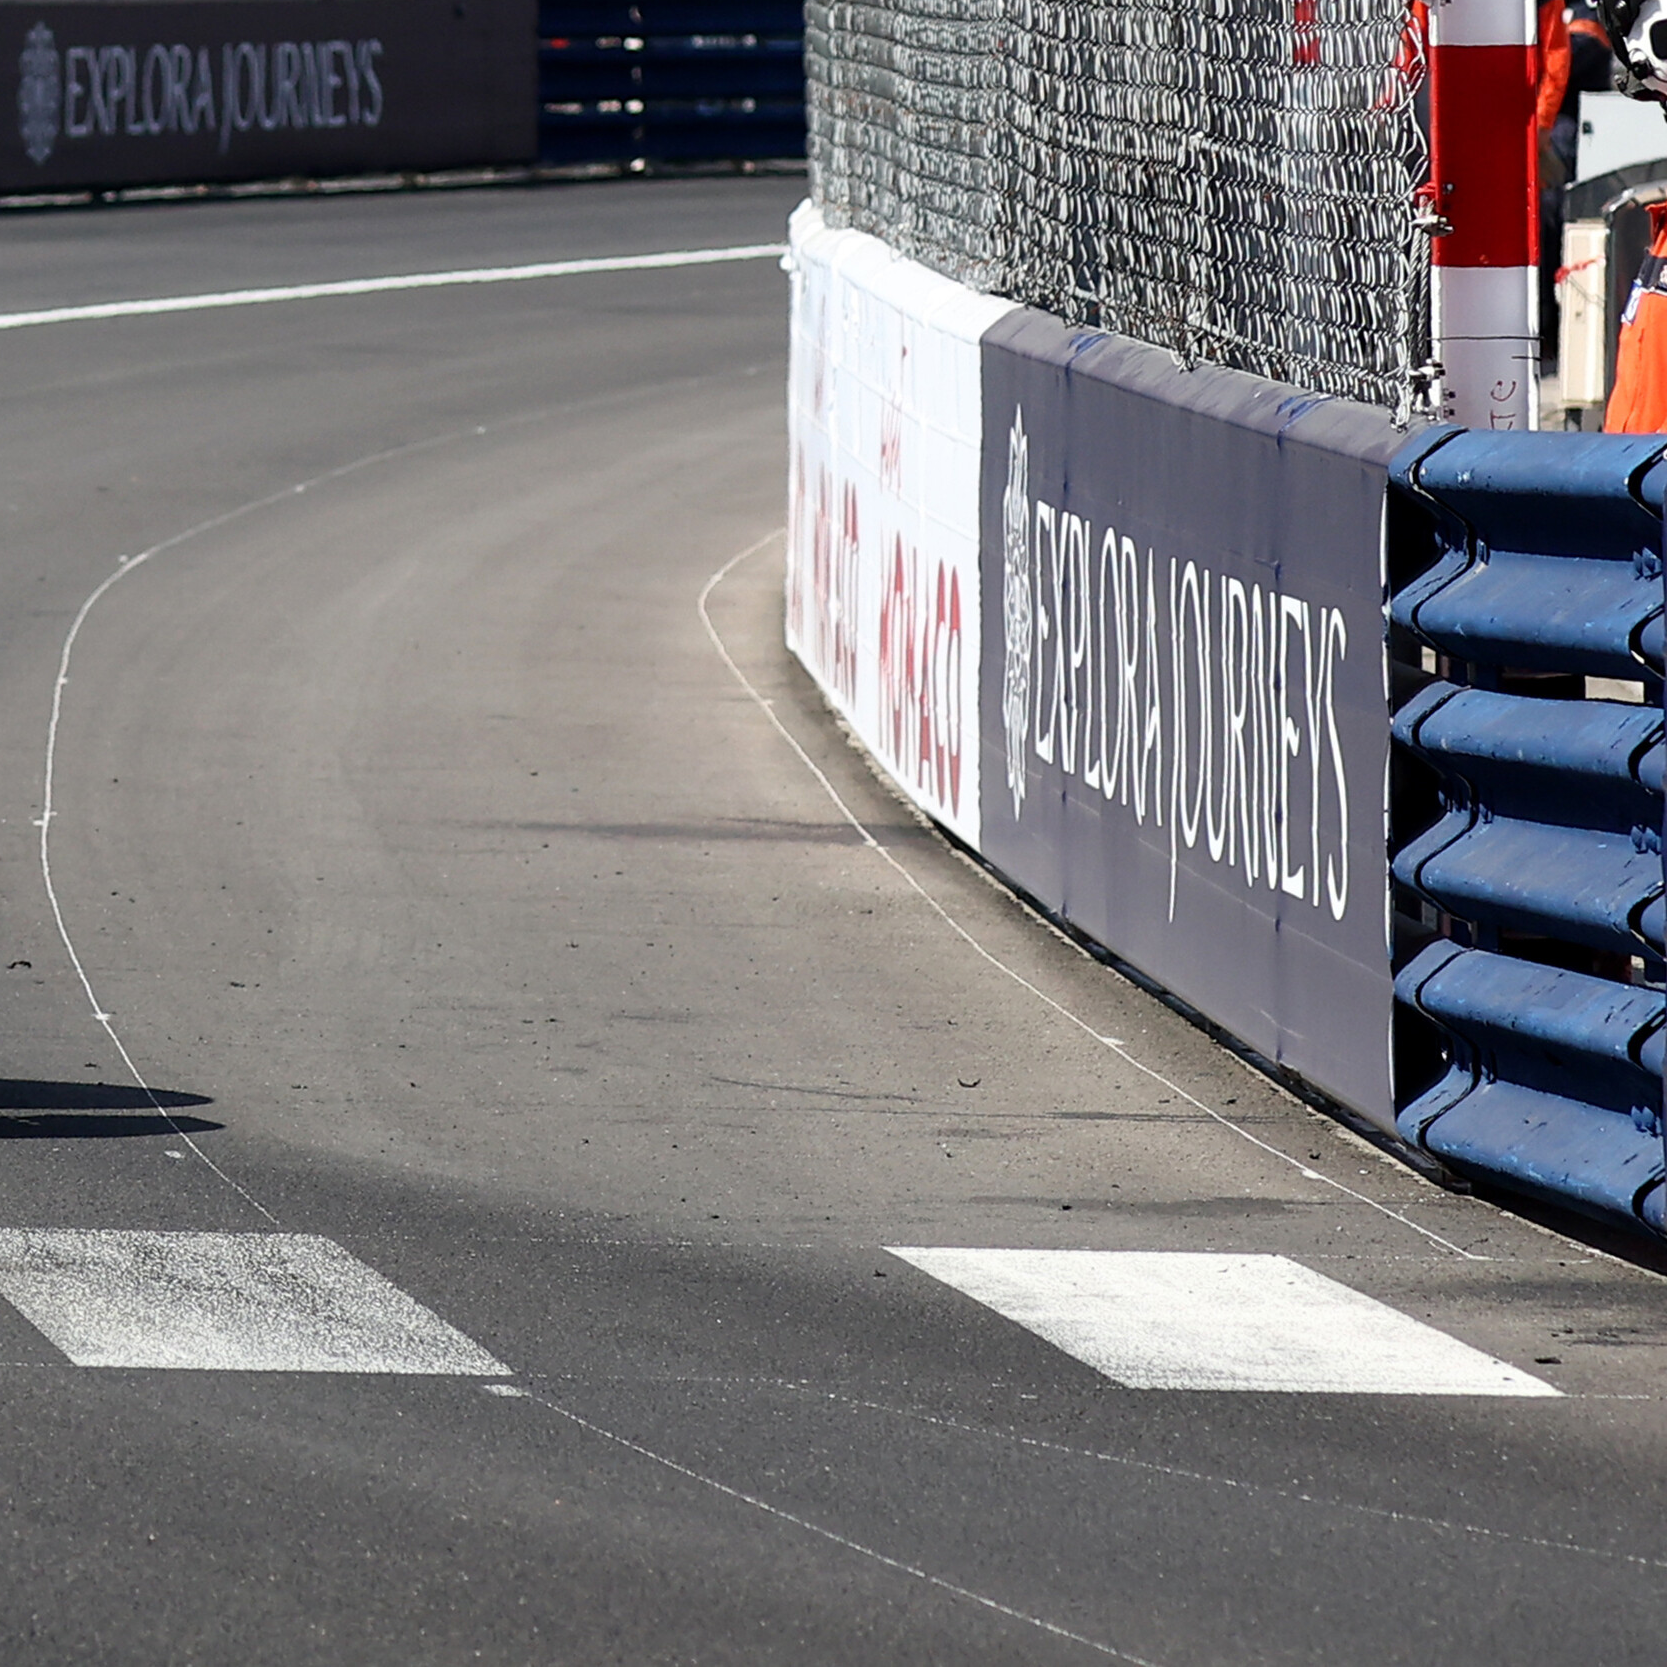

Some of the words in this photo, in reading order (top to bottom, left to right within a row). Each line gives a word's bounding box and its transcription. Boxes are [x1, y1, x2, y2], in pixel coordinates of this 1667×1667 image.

[67, 42, 216, 137] EXPLORA
[218, 37, 384, 155] JOURNEYS
[878, 527, 962, 820] MONACO
[1034, 497, 1164, 829] EXPLORA
[1167, 555, 1349, 924] JOURNEYS
